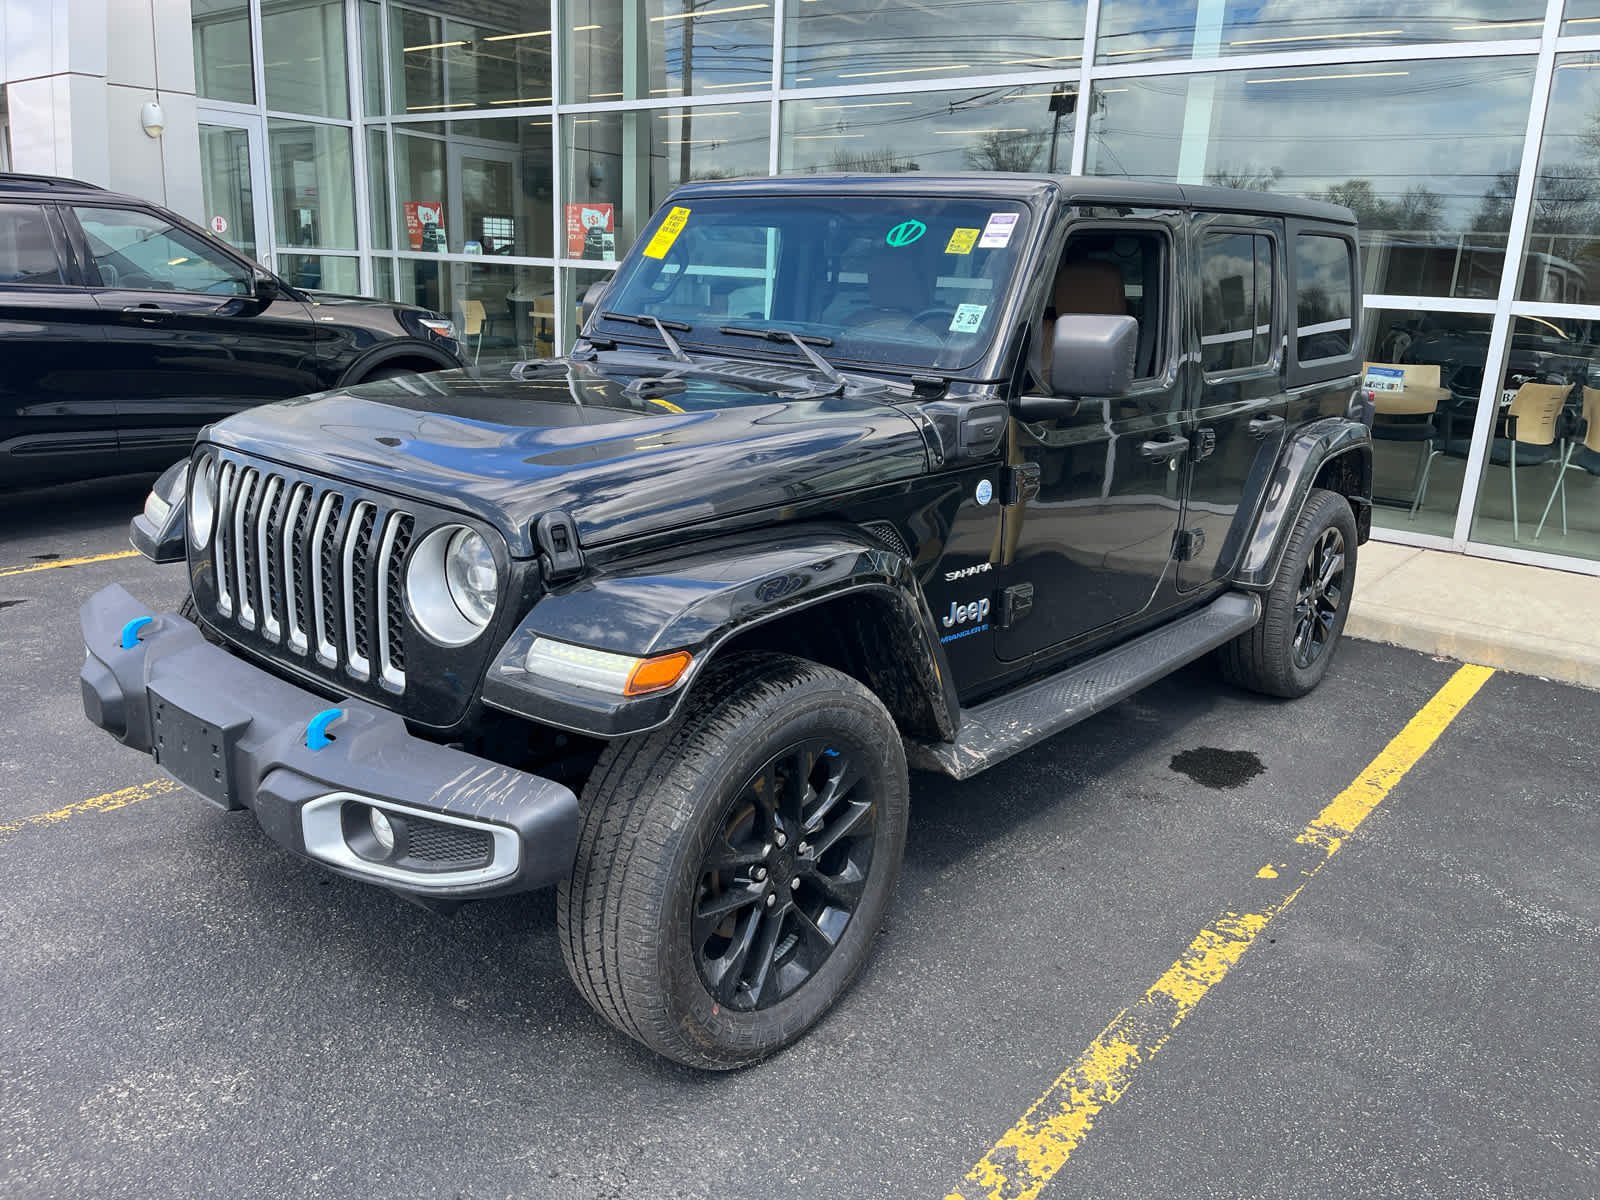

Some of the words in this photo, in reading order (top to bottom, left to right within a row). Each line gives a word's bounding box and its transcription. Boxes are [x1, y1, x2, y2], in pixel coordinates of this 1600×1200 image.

[956, 312, 964, 324] 5
[945, 562, 992, 581] SAHARA
[942, 598, 990, 628] Jeep
[940, 626, 981, 643] WRANGLER
